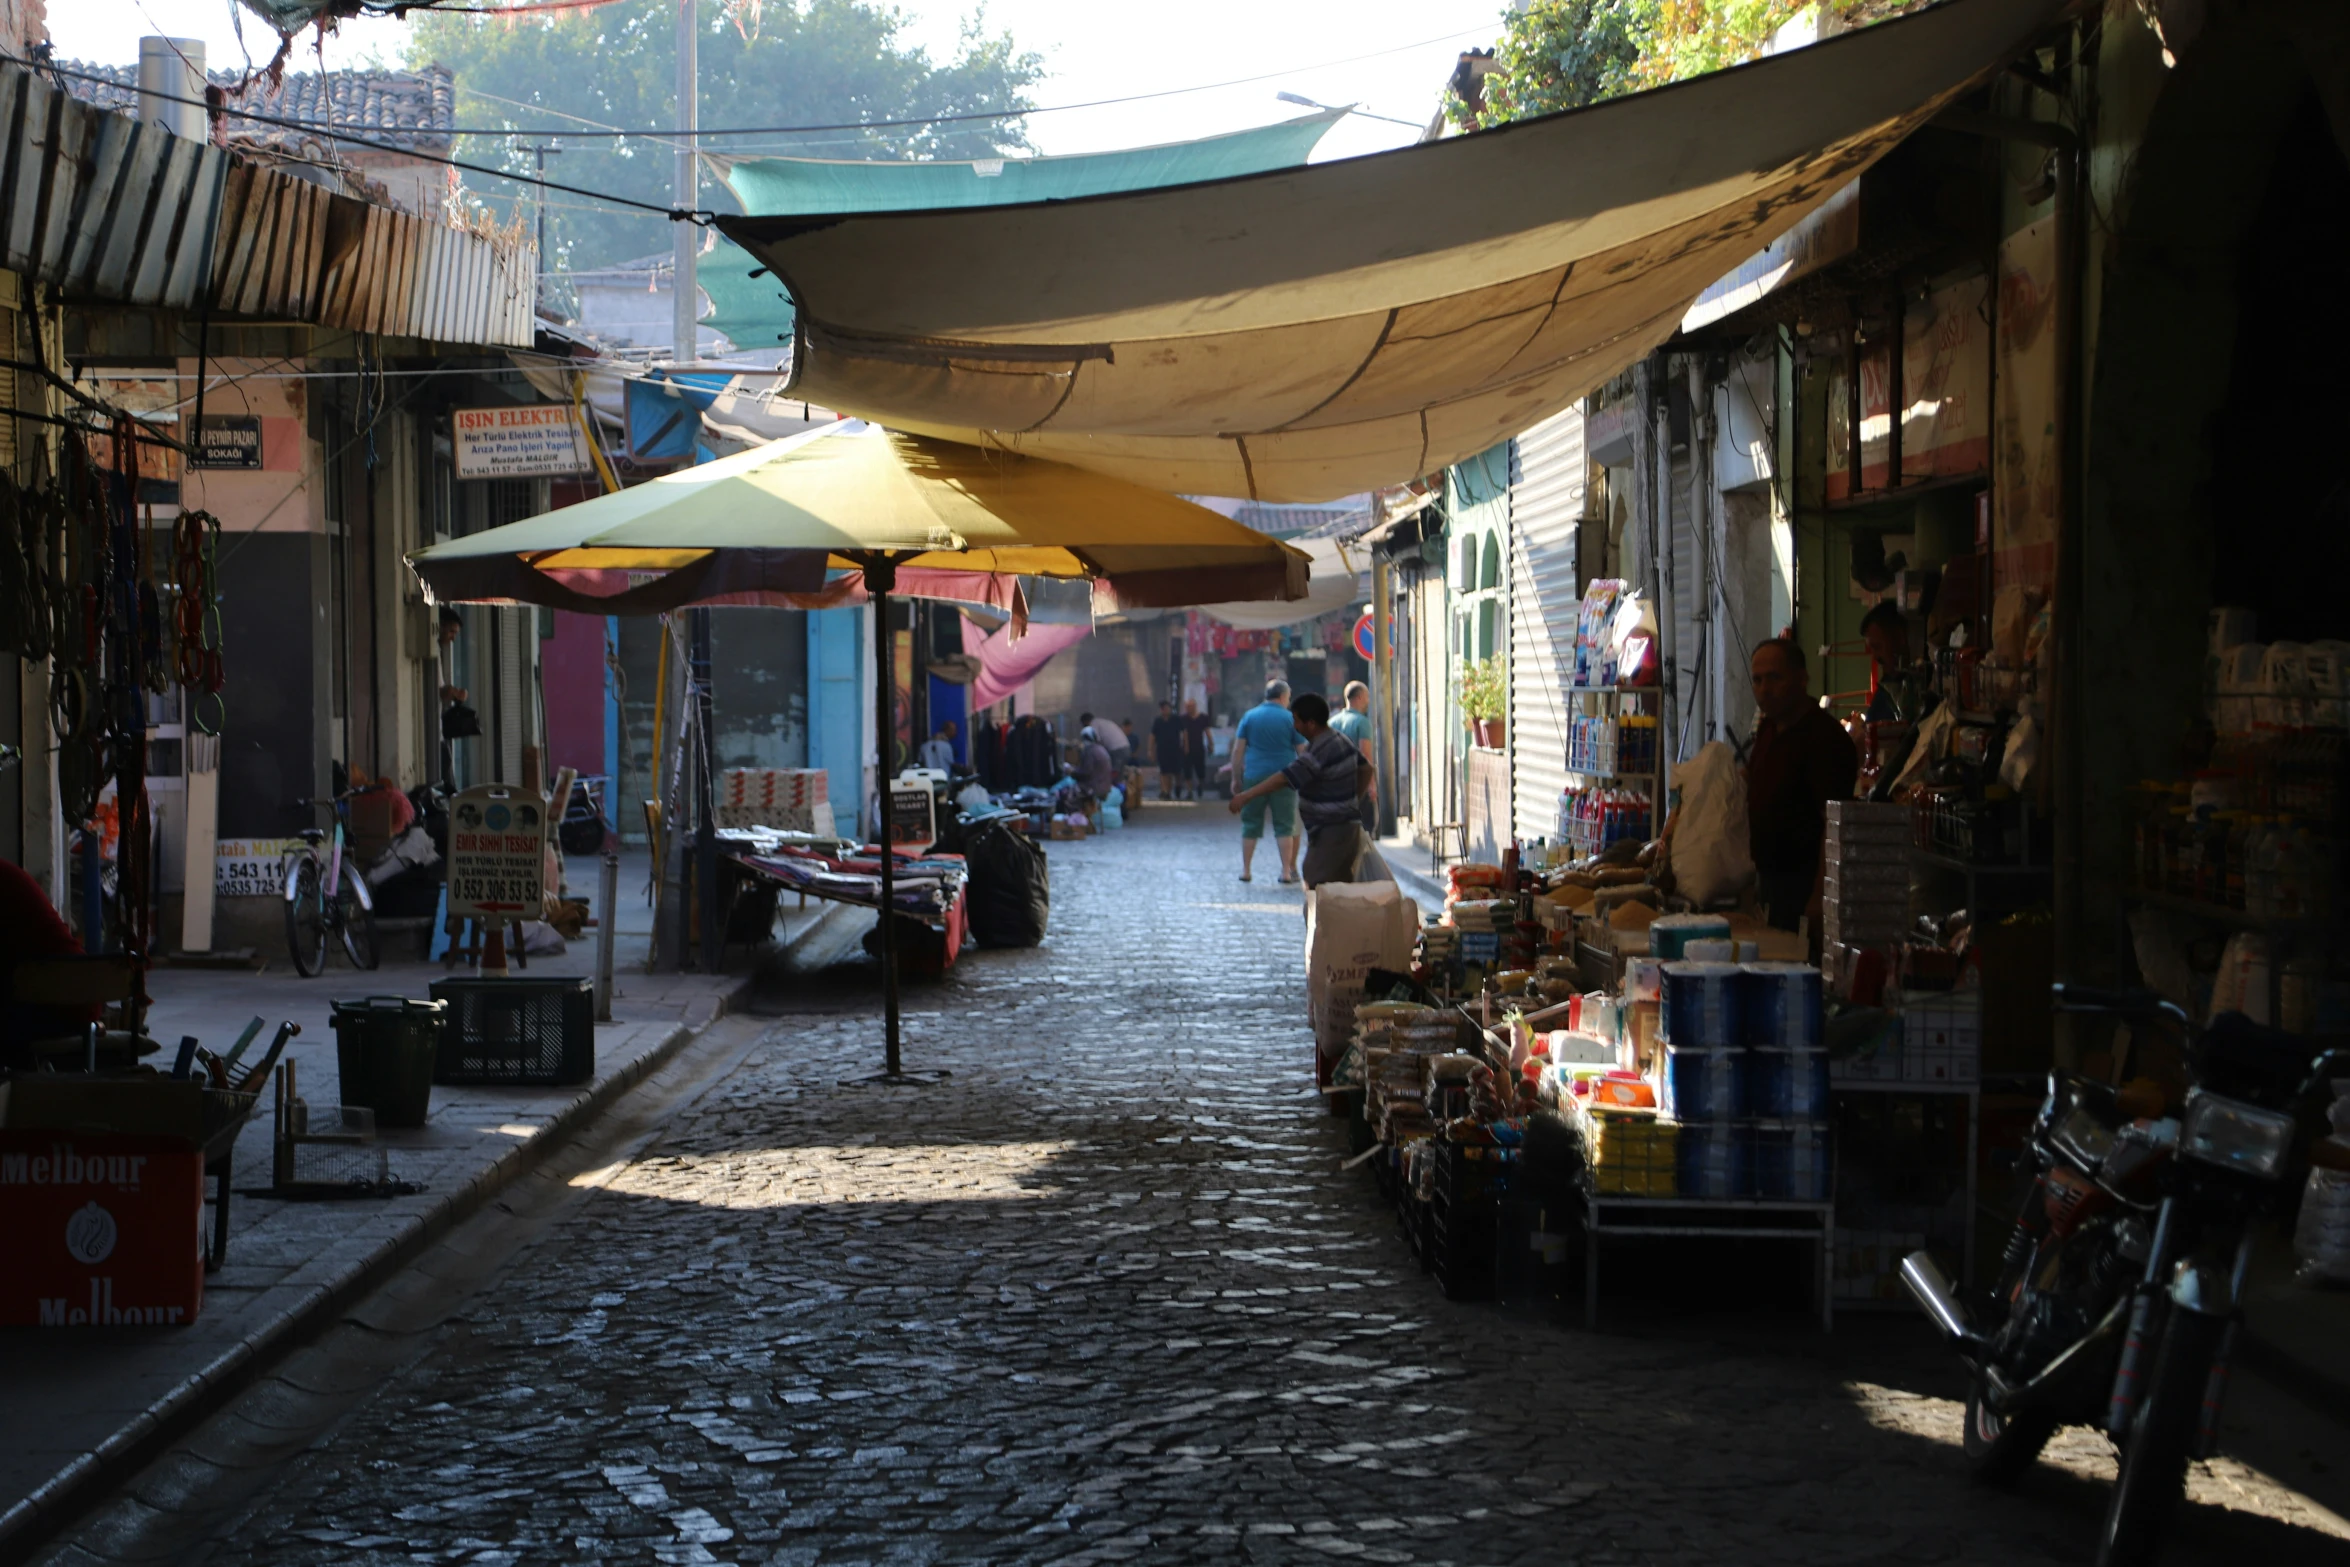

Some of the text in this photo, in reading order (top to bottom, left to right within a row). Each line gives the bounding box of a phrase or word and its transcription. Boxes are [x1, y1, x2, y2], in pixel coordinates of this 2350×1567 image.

[458, 408, 578, 432] IŞIN ELEKTR
[207, 427, 232, 446] PEYNİR
[233, 430, 257, 446] PAZARI
[464, 432, 480, 443] Her
[483, 431, 507, 442] Türlü
[509, 429, 543, 440] Elektrik
[207, 446, 243, 459] SOKAĞI
[471, 445, 494, 454] Arıza
[497, 443, 518, 453] Pano
[520, 442, 543, 454] İşleri
[490, 456, 523, 465] Mustafa
[505, 832, 539, 853] TESİSAT
[456, 855, 537, 868] HER TÜRLÜ TESİSAT
[229, 862, 258, 878] 543
[264, 862, 281, 877] 11
[255, 879, 275, 893] 725
[454, 878, 538, 902] 0 552 306 53 52
[0, 1142, 147, 1185] Melbour
